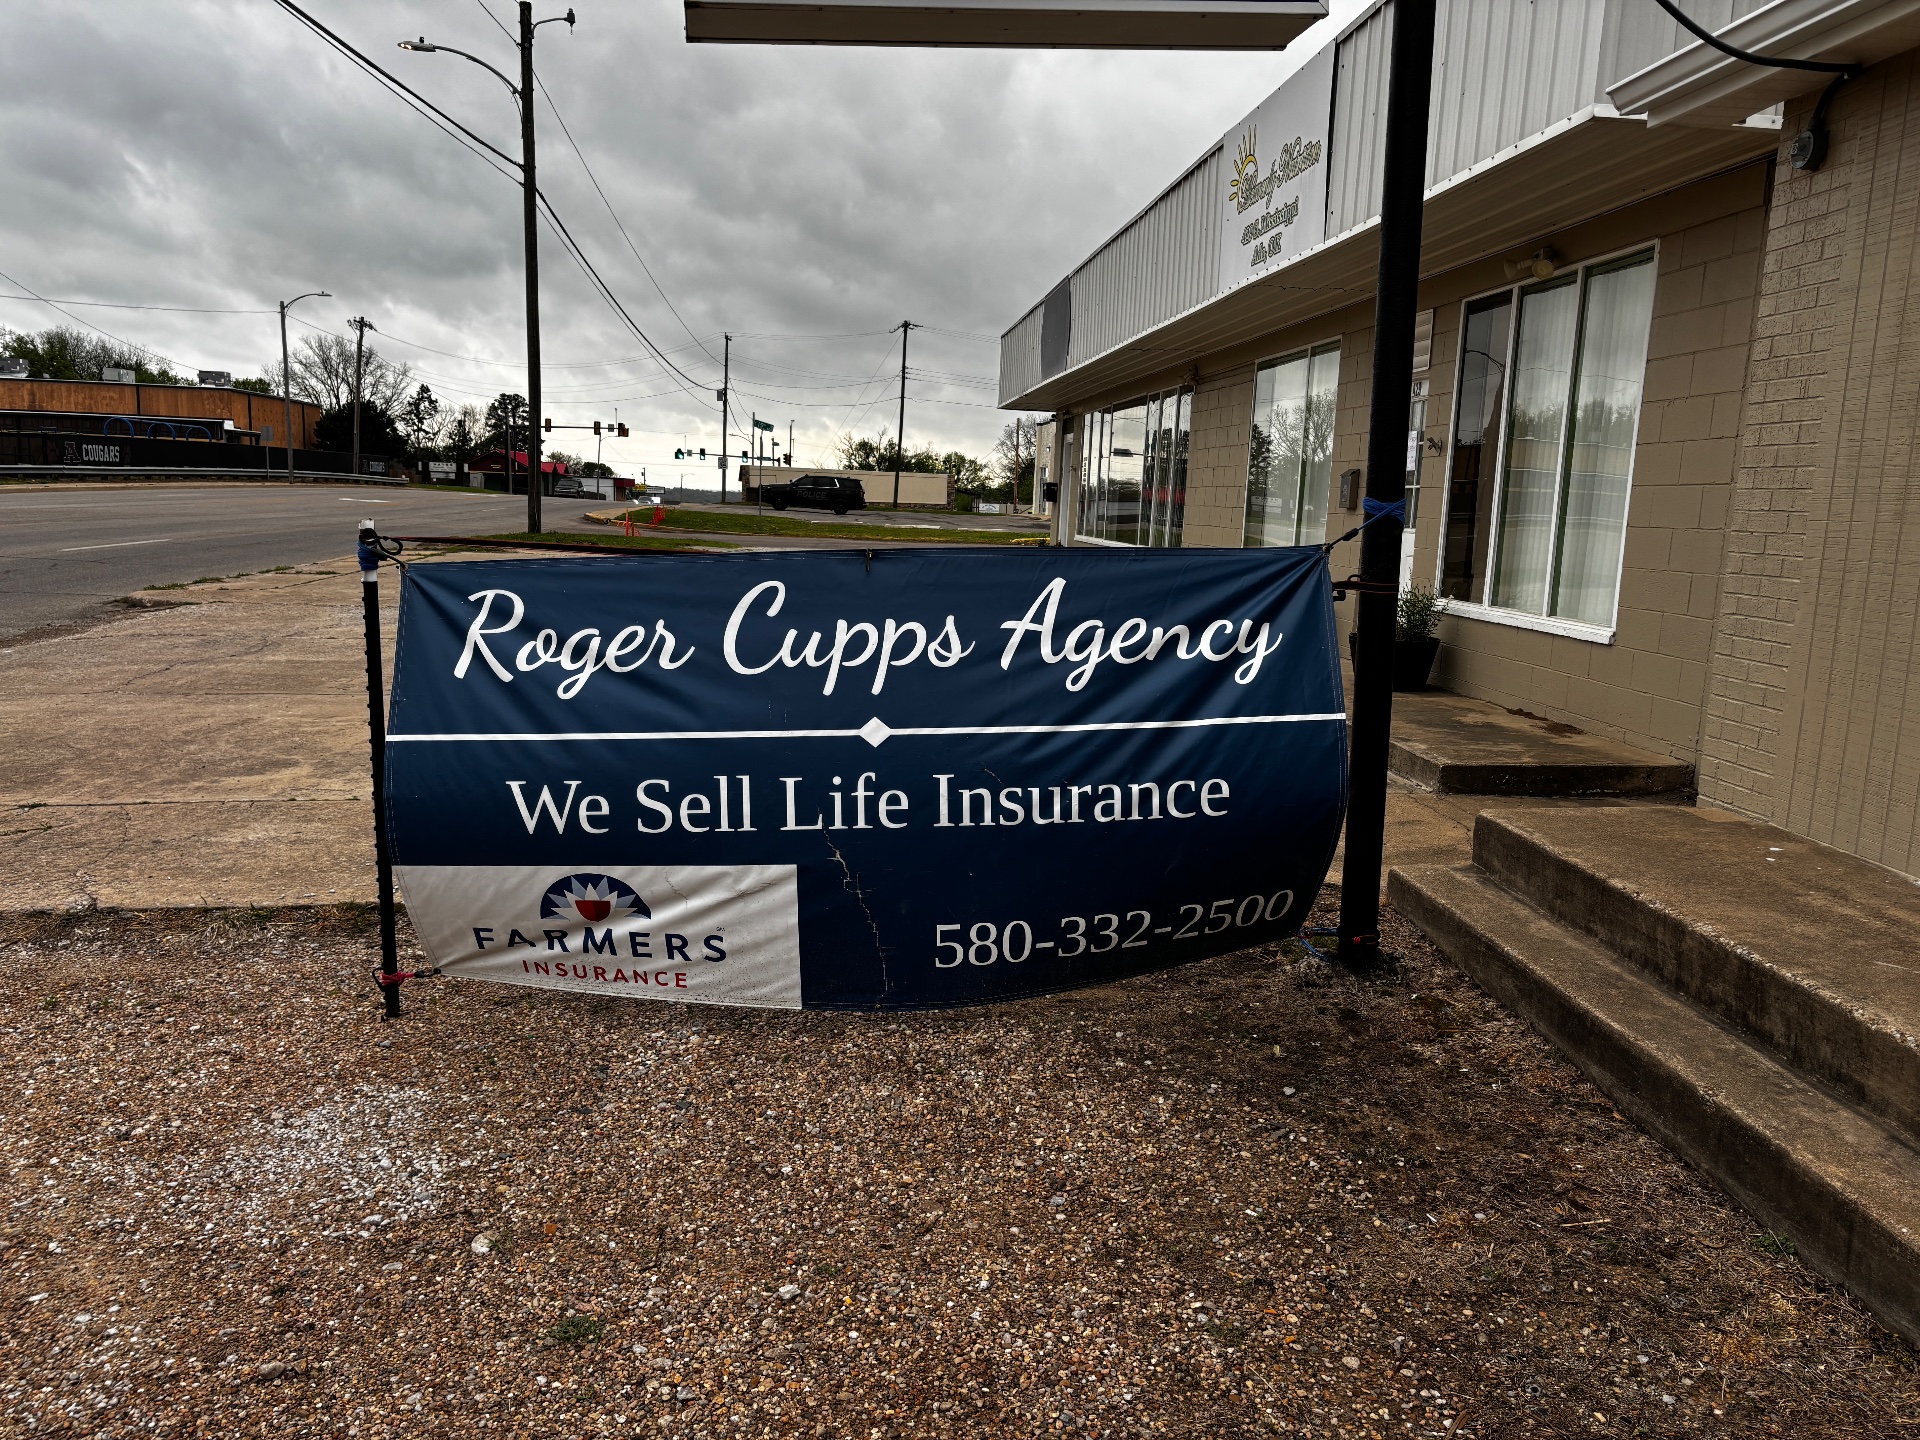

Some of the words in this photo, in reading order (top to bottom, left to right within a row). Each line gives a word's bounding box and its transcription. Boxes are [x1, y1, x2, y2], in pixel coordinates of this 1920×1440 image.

[82, 444, 120, 462] COUGARS
[797, 490, 827, 499] POLICE
[454, 589, 695, 700] Roger
[723, 581, 975, 697] Cupps
[1000, 577, 1283, 692] Agency
[506, 780, 610, 835] We
[636, 774, 757, 834] Sell
[779, 771, 909, 831] Life
[932, 773, 1230, 828] Insurance
[473, 926, 727, 963] FARMERS
[935, 889, 1295, 969] 580-332-2500
[522, 959, 688, 989] INSURANCE
